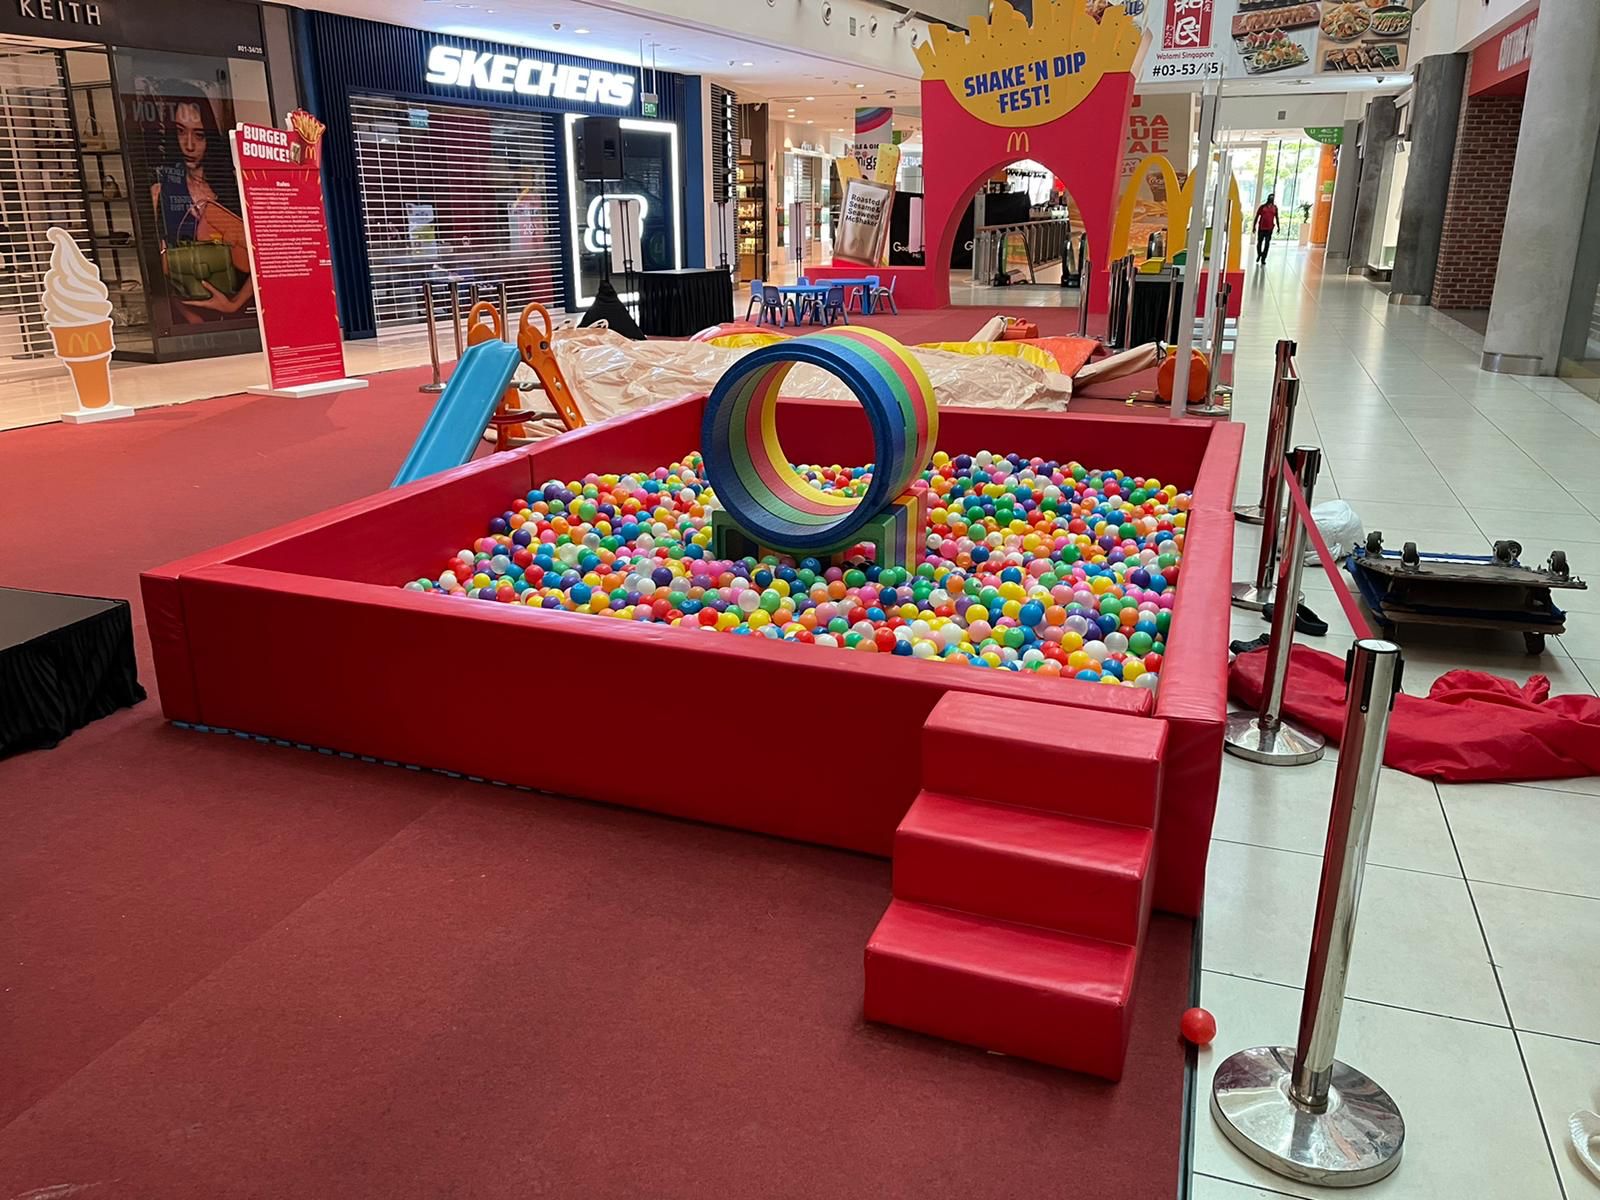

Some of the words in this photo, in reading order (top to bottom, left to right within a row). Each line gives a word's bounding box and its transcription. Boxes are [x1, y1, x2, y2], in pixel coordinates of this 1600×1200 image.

[21, 0, 101, 25] KEITH
[1182, 51, 1215, 60] Singapore
[425, 45, 635, 107] SKECHERS
[964, 65, 1026, 98] SHAKE
[1053, 51, 1087, 78] DIP
[999, 84, 1051, 114] FEST!
[243, 125, 288, 146] BURGER
[242, 141, 290, 163] BOUNCE!
[851, 193, 881, 206] Roasted
[845, 215, 878, 227] McShaker
[847, 208, 880, 221] Seaweed
